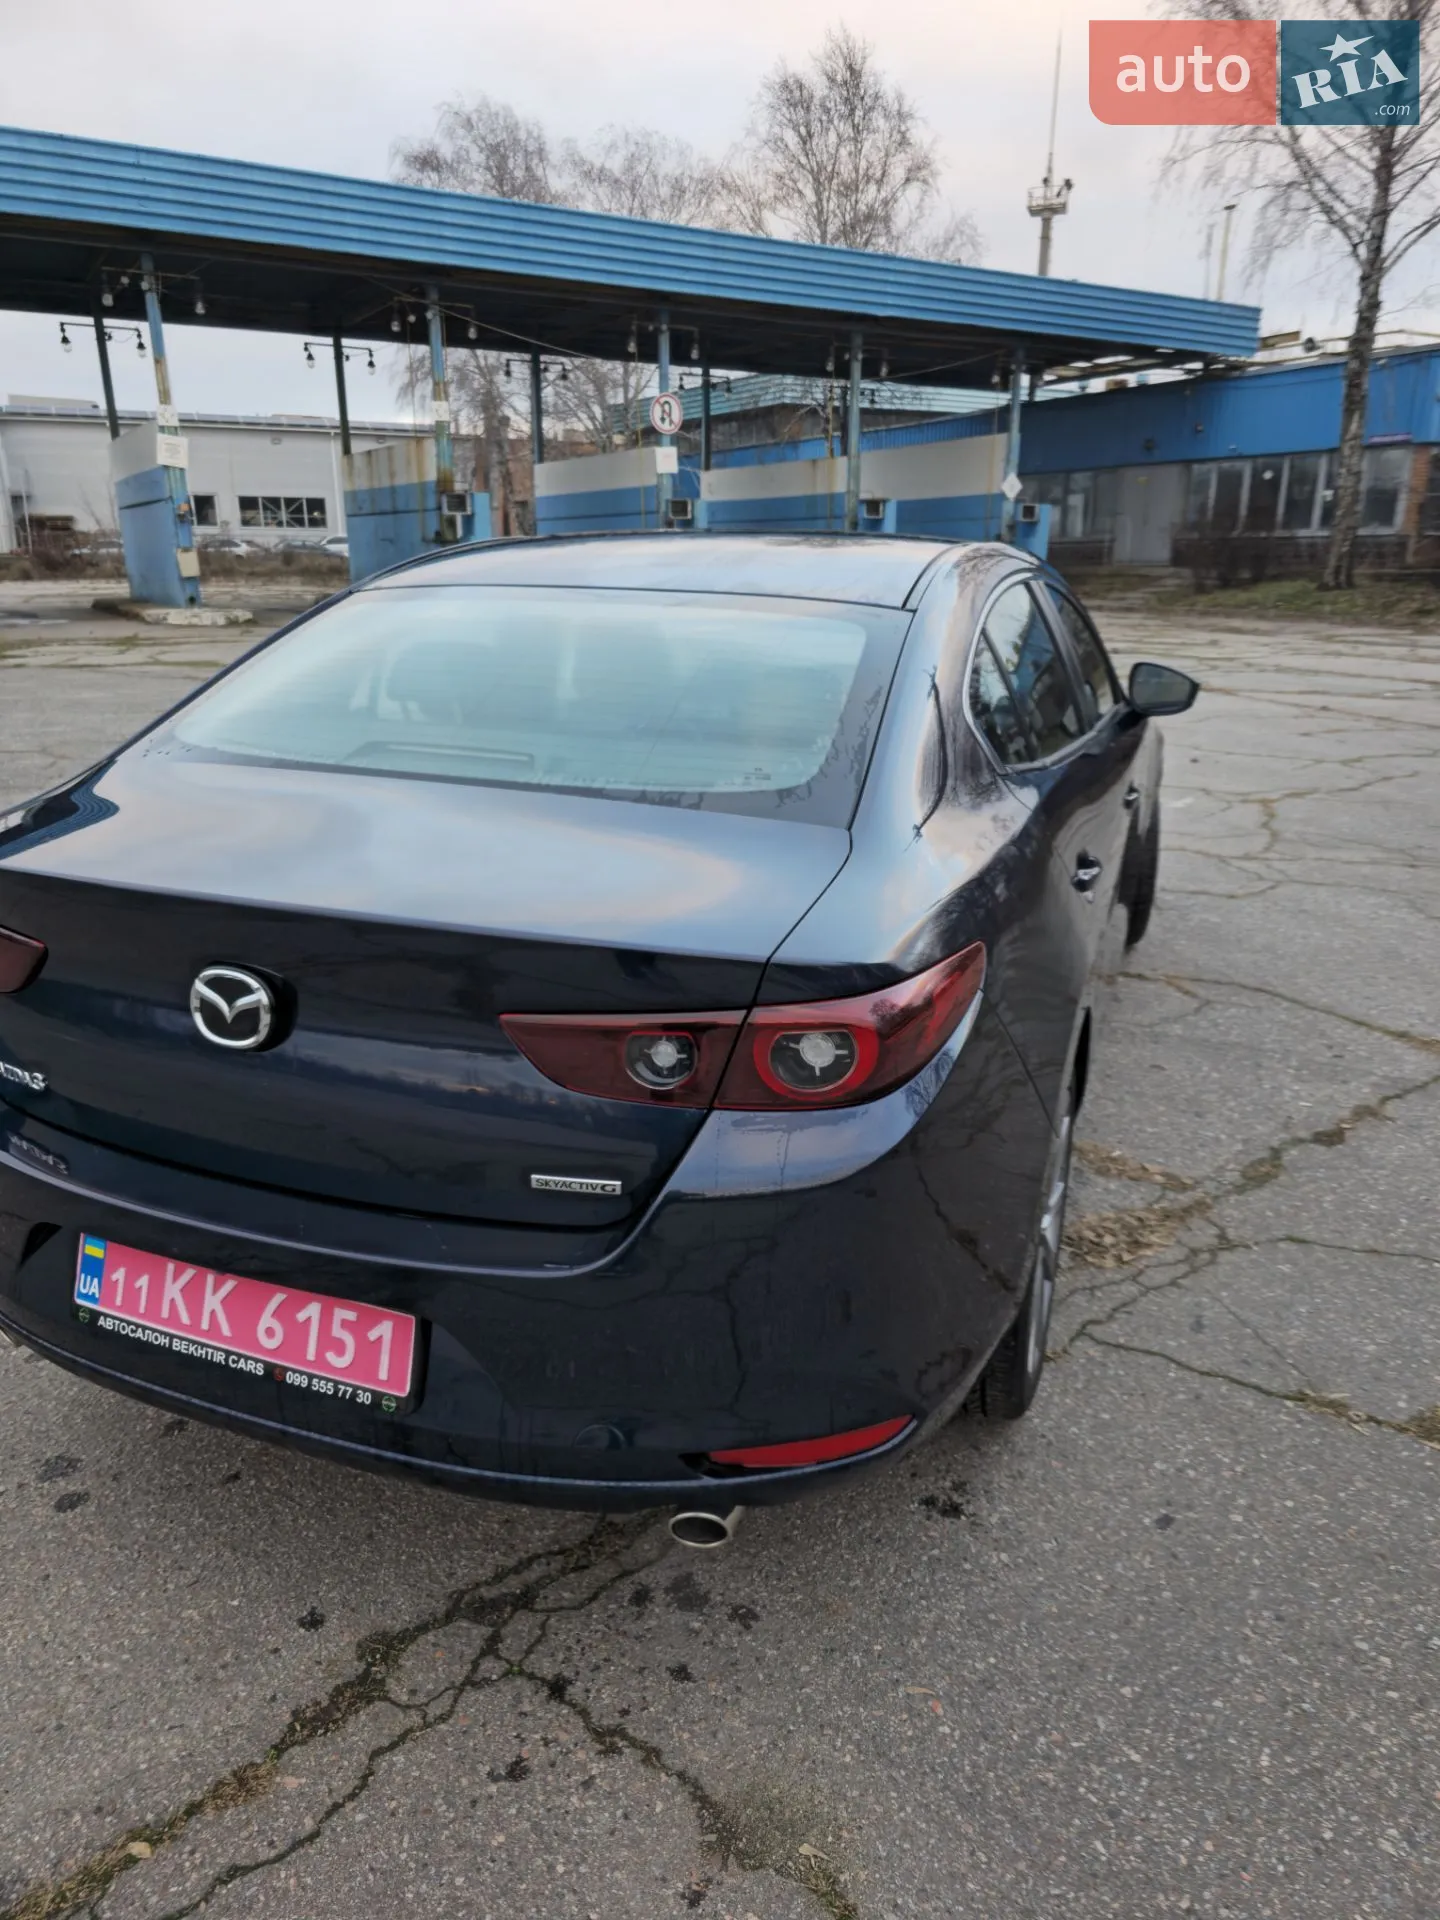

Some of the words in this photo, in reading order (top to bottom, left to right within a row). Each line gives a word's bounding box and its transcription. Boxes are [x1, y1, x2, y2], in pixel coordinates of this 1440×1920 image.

[79, 1273, 99, 1298] UA
[97, 1315, 170, 1348] АВТОСАЛОН
[172, 1338, 226, 1365] BEKHTIR
[228, 1355, 265, 1376] CARS
[285, 1371, 309, 1388] 099
[311, 1378, 335, 1395] 555
[337, 1385, 354, 1400] 77
[355, 1390, 372, 1405] 30
[256, 1293, 393, 1381] 6151
